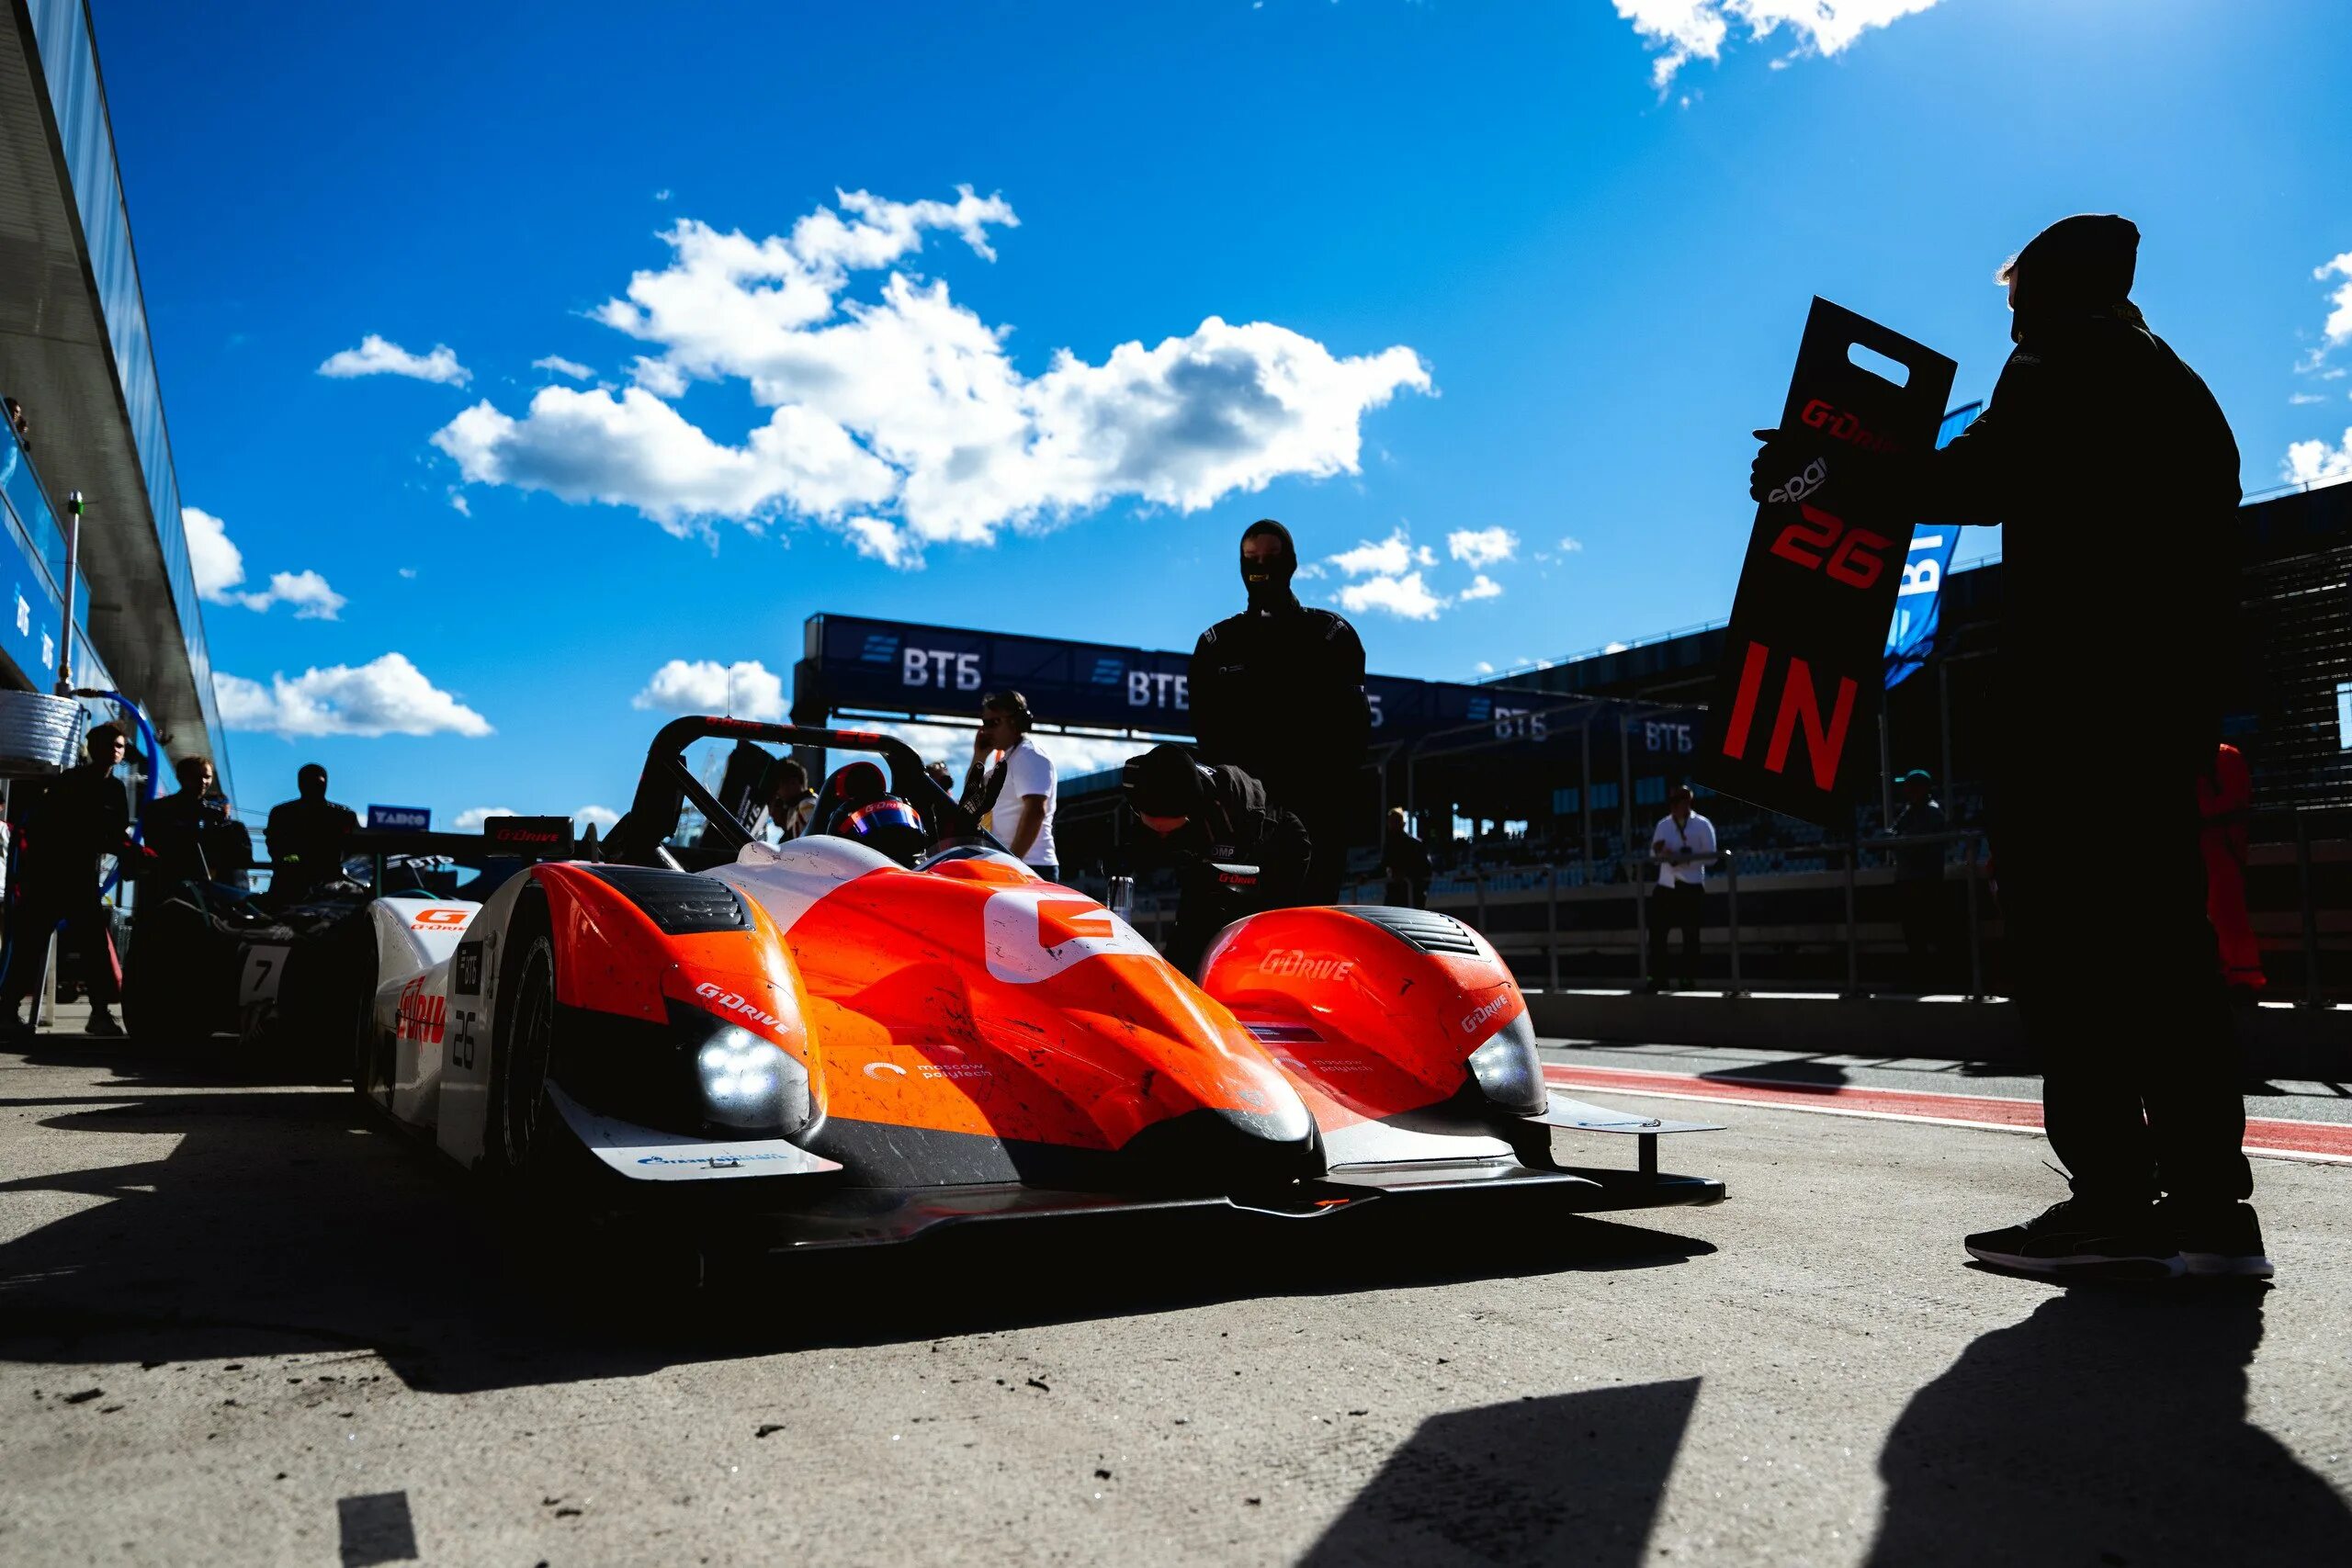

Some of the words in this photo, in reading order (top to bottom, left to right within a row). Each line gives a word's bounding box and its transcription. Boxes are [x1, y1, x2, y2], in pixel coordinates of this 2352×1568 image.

[1769, 502, 1896, 590] 26
[902, 646, 983, 692] ВТБ
[1722, 639, 1859, 794] IN
[253, 960, 273, 992] 7
[922, 1069, 993, 1079] polytech
